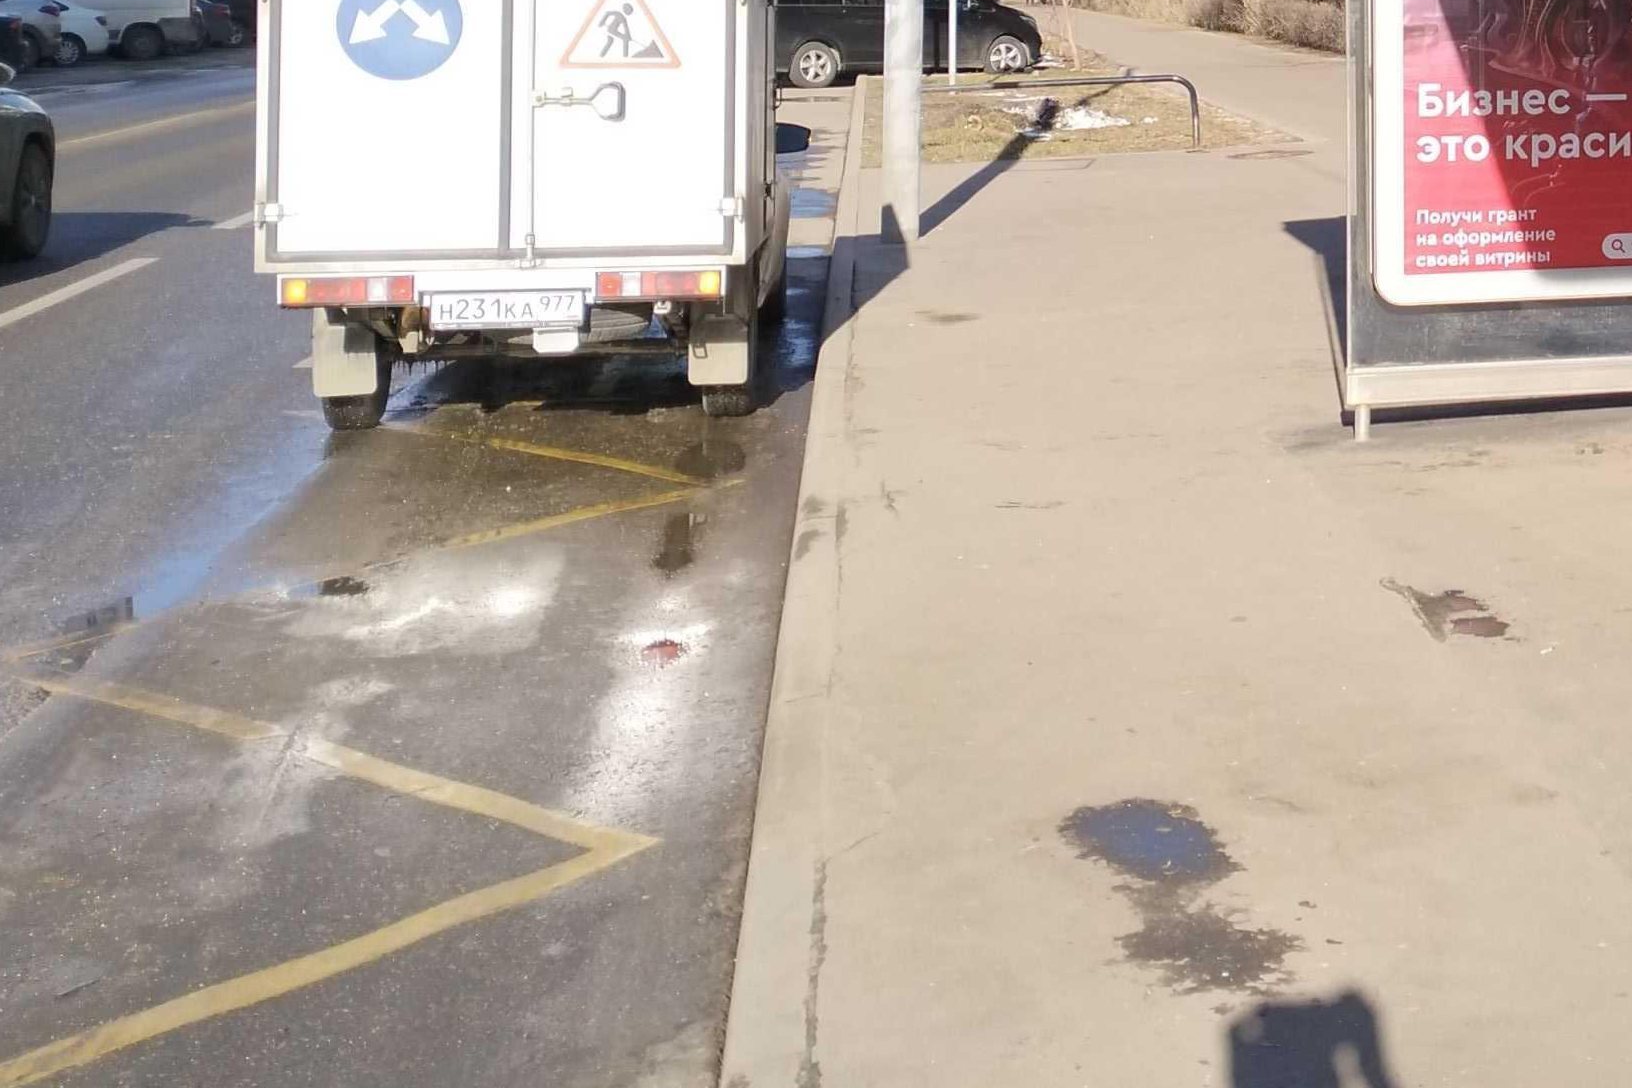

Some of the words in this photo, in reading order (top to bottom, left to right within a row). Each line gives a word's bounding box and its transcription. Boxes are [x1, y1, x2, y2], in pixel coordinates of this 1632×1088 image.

[1417, 82, 1571, 118] Бизнес
[1415, 133, 1491, 163] это
[1416, 208, 1483, 227] Получи
[1488, 209, 1538, 225] грант
[1416, 233, 1438, 246] на
[1443, 228, 1557, 248] оформление
[1416, 249, 1470, 268] своей
[1475, 251, 1551, 268] витрины
